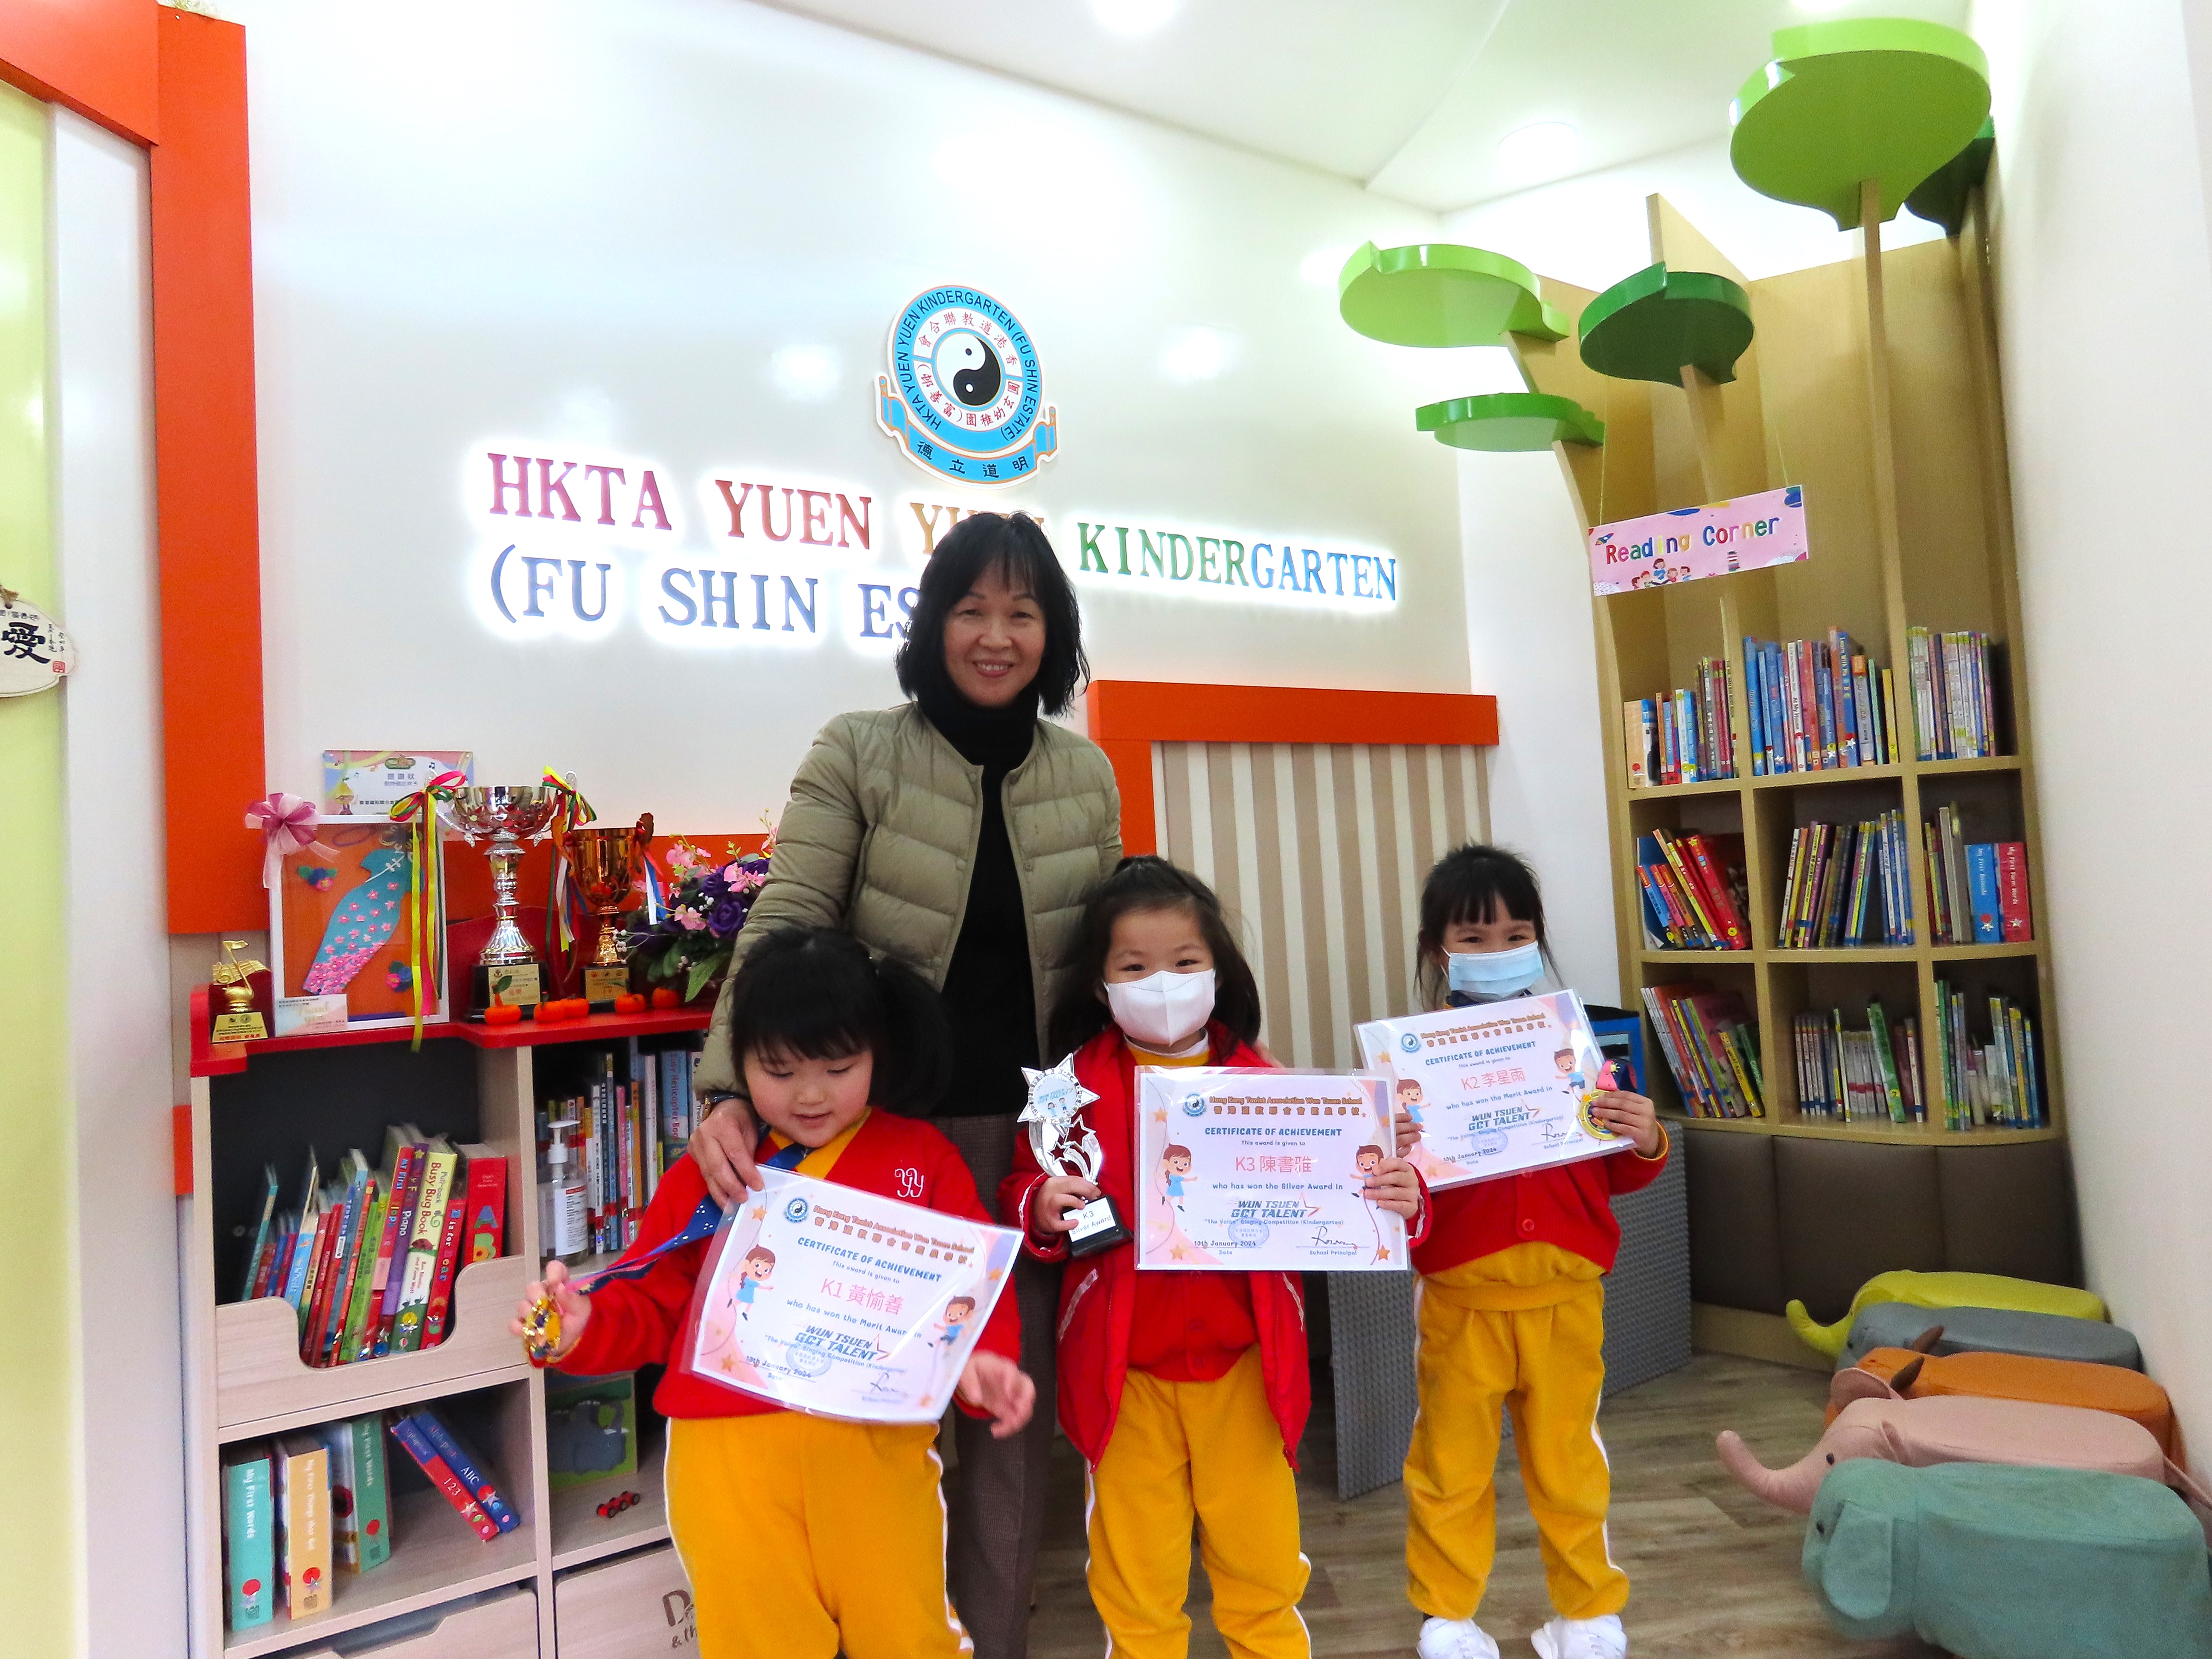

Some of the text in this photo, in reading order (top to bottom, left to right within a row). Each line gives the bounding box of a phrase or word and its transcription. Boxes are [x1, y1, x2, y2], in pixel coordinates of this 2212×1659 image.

[897, 290, 1037, 441] HKTA YUEN YUEN KINDERGARTEN (FU SHIN ESTATE)
[487, 453, 672, 530] HKTA
[715, 479, 871, 550] YUEN
[1077, 523, 1396, 600] KINDERGARTEN
[1606, 516, 1780, 565] Reading Corner
[491, 544, 611, 623] (FU
[658, 568, 818, 633] SHIN
[3, 622, 51, 664] 愛
[1426, 1051, 1472, 1065] CERTIFICATE
[1485, 1041, 1536, 1055] ACHIEVEMENT
[1461, 1068, 1525, 1090] K2 李星雨
[1209, 1096, 1227, 1105] Hong
[1228, 1096, 1244, 1105] Kong
[1472, 1106, 1522, 1121] WUN TSUEN
[1493, 1112, 1530, 1126] TALENT
[1205, 1127, 1262, 1135] CERTIFICATE
[1279, 1128, 1342, 1136] ACHIEVEMENT
[1235, 1156, 1255, 1171] K3
[417, 1162, 441, 1234] Busy Bug Book
[399, 1210, 412, 1236] Piano
[1071, 1215, 1112, 1235] Silver Award
[1083, 1210, 1094, 1220] K3
[1261, 1209, 1307, 1218] TALENT
[798, 1237, 942, 1282] CERTIFICATE OF ACHIEVEMENT
[820, 1278, 843, 1298] K1
[787, 1299, 803, 1308] who
[806, 1303, 821, 1313] has
[824, 1310, 840, 1319] won
[843, 1314, 857, 1324] the
[885, 1325, 909, 1337] Awar
[805, 1324, 874, 1349] WUN TSUEN
[828, 1341, 878, 1361] TALENT
[242, 1468, 256, 1539] My First Words
